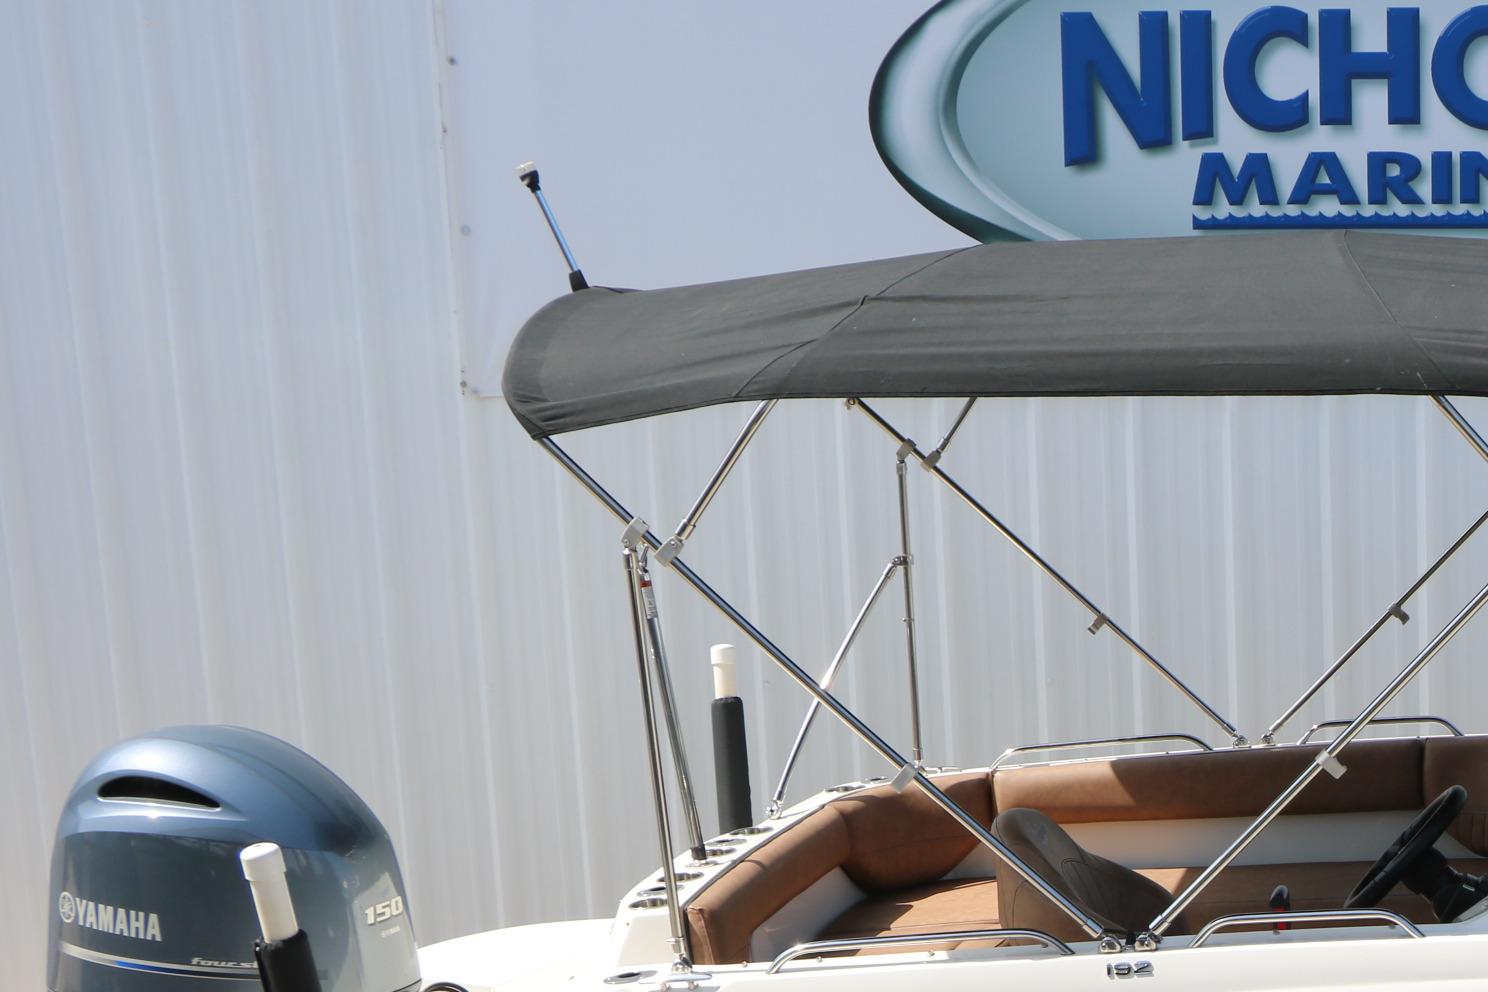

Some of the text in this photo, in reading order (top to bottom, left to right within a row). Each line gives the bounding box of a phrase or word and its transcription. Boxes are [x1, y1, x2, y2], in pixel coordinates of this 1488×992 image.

[75, 897, 163, 942] YAMAHA
[365, 895, 404, 926] 150
[1106, 960, 1155, 980] 192
